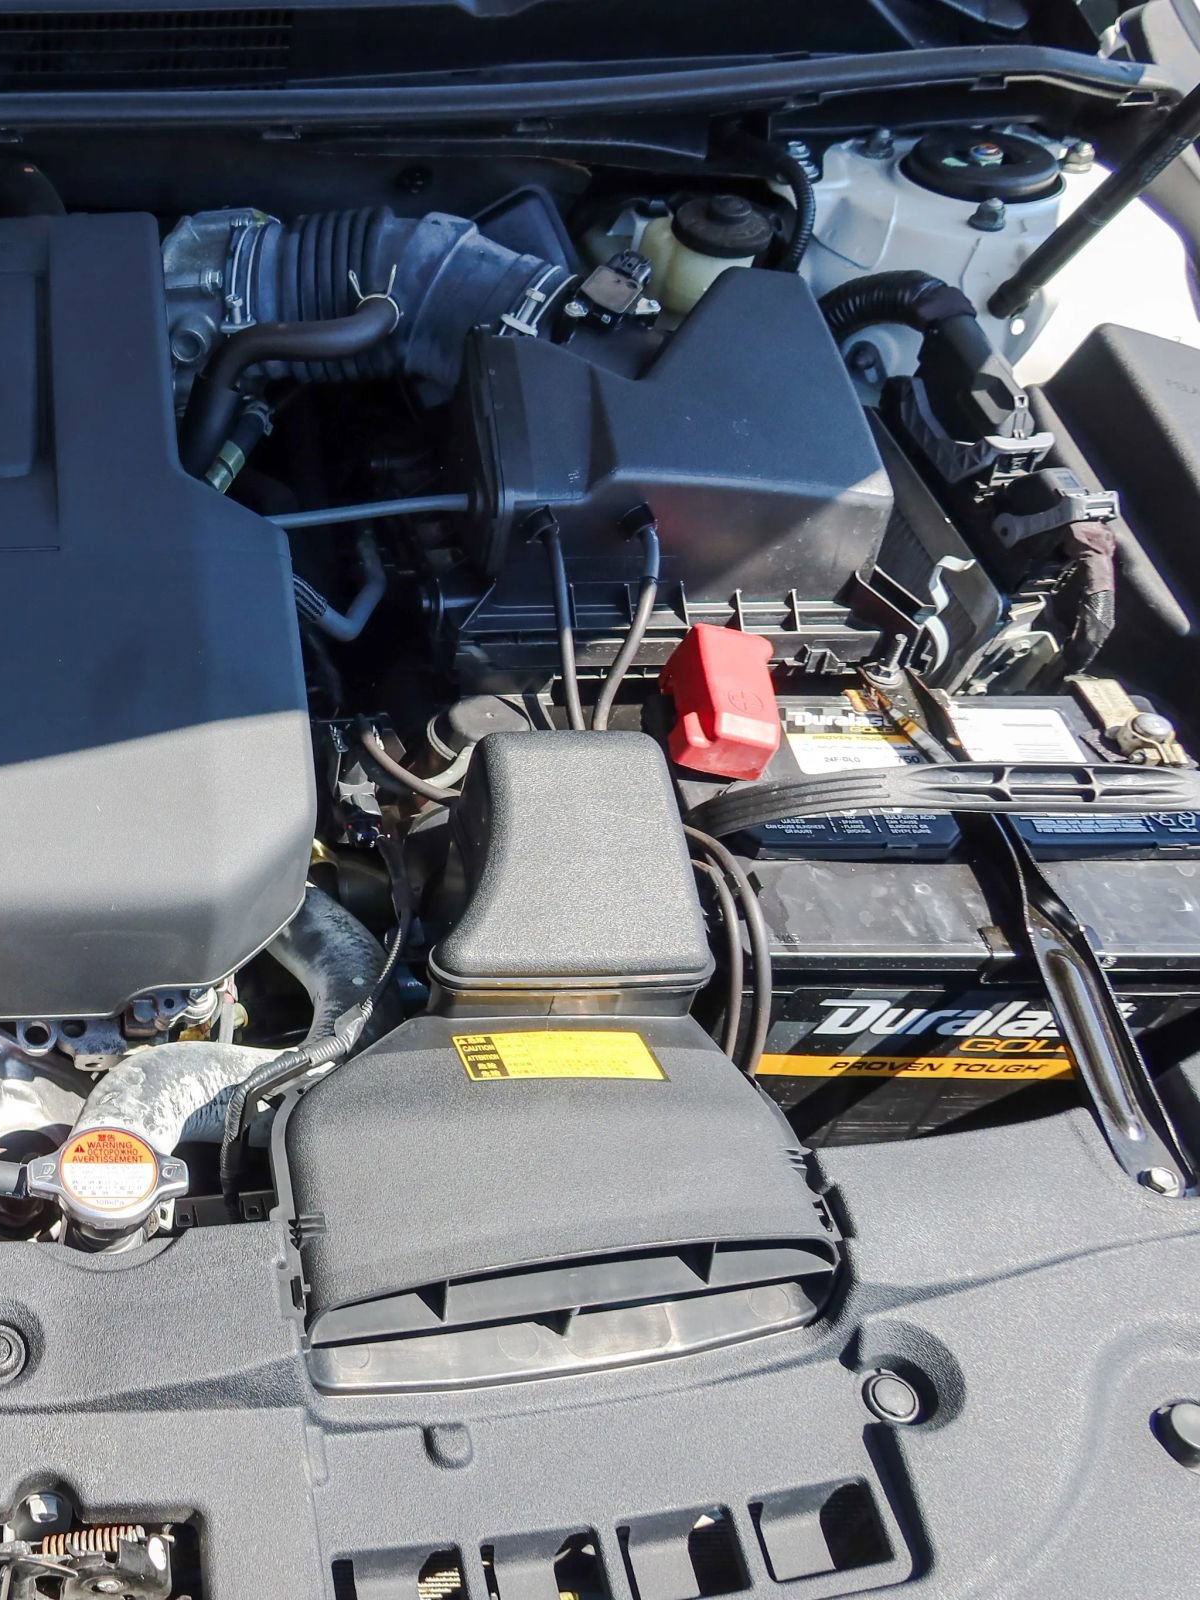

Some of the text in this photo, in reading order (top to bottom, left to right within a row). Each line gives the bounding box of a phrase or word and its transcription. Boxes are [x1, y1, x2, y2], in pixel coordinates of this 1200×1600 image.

[894, 755, 921, 764] 750
[462, 1044, 496, 1052] CAUTION
[959, 1038, 1067, 1053] GOL
[467, 1053, 500, 1062] ATTENTION
[829, 1061, 1040, 1074] PROVEN TOUGH
[87, 1141, 133, 1149] WARNING
[72, 1155, 144, 1163] AVERTISSEMENT
